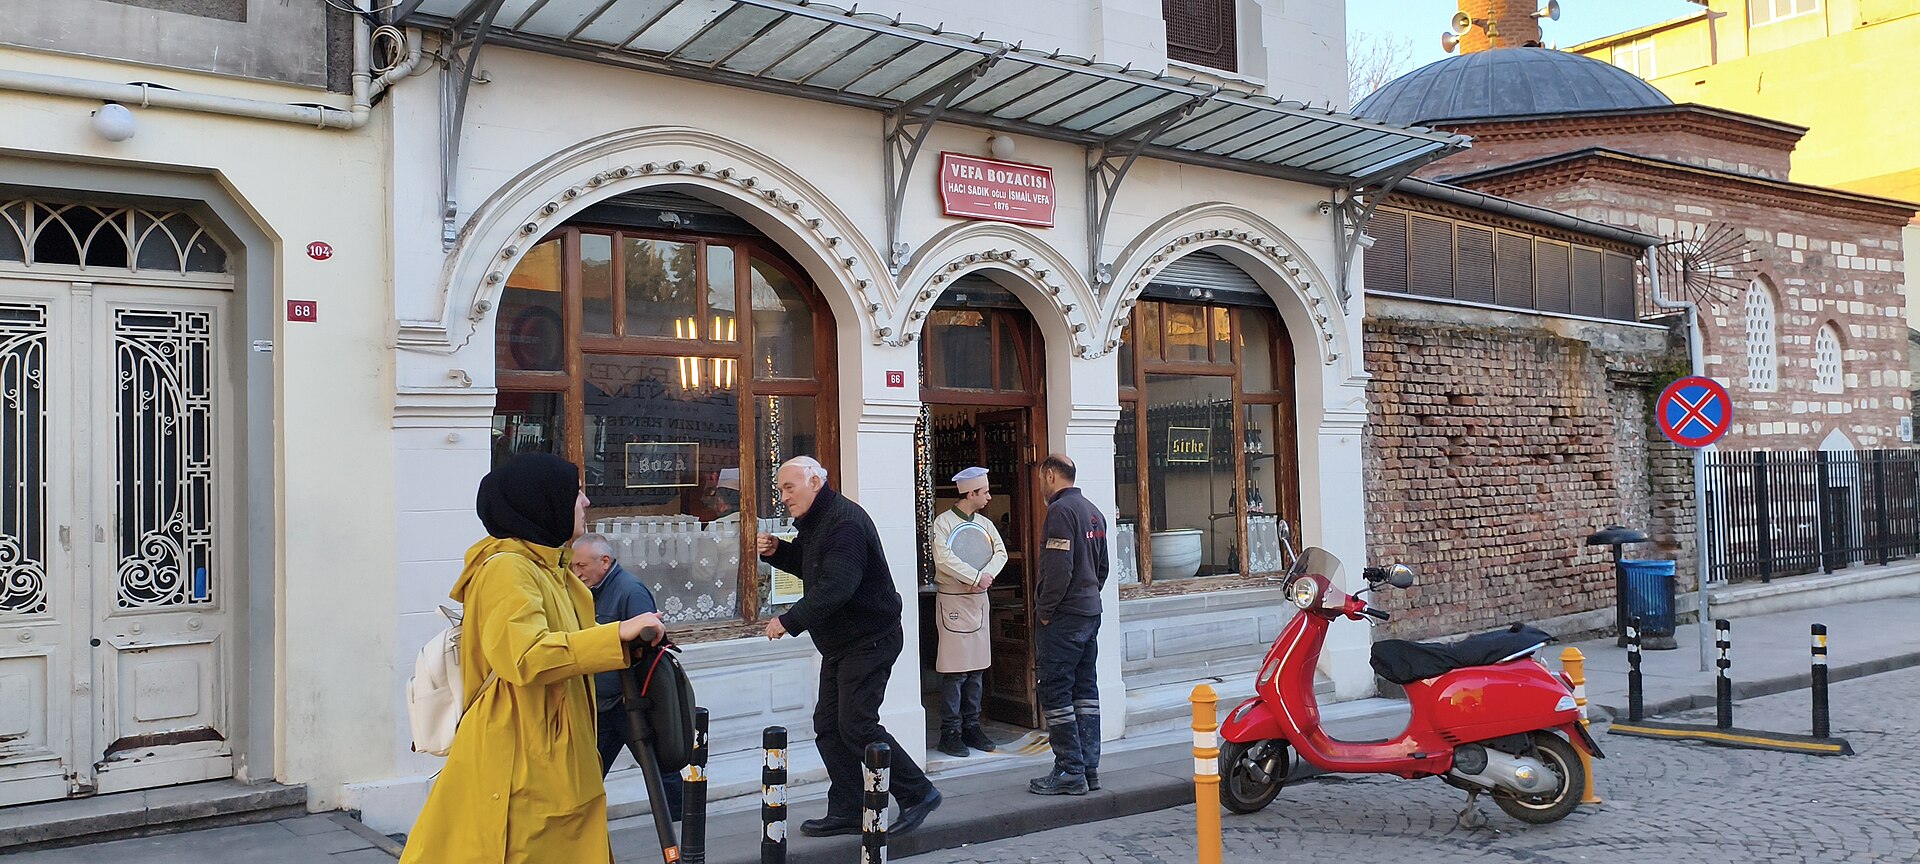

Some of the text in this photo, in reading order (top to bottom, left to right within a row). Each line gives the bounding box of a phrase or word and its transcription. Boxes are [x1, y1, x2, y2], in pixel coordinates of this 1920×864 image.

[951, 164, 1047, 189] VEFA BOZACISI
[948, 182, 966, 193] HACI
[967, 185, 990, 197] SADIK
[1008, 188, 1031, 202] İSMAİL
[1033, 193, 1050, 205] VEFA
[993, 201, 1009, 211] 1876
[310, 245, 329, 257] 104
[294, 304, 310, 317] 68
[890, 374, 901, 384] 66
[639, 457, 687, 474] Boza
